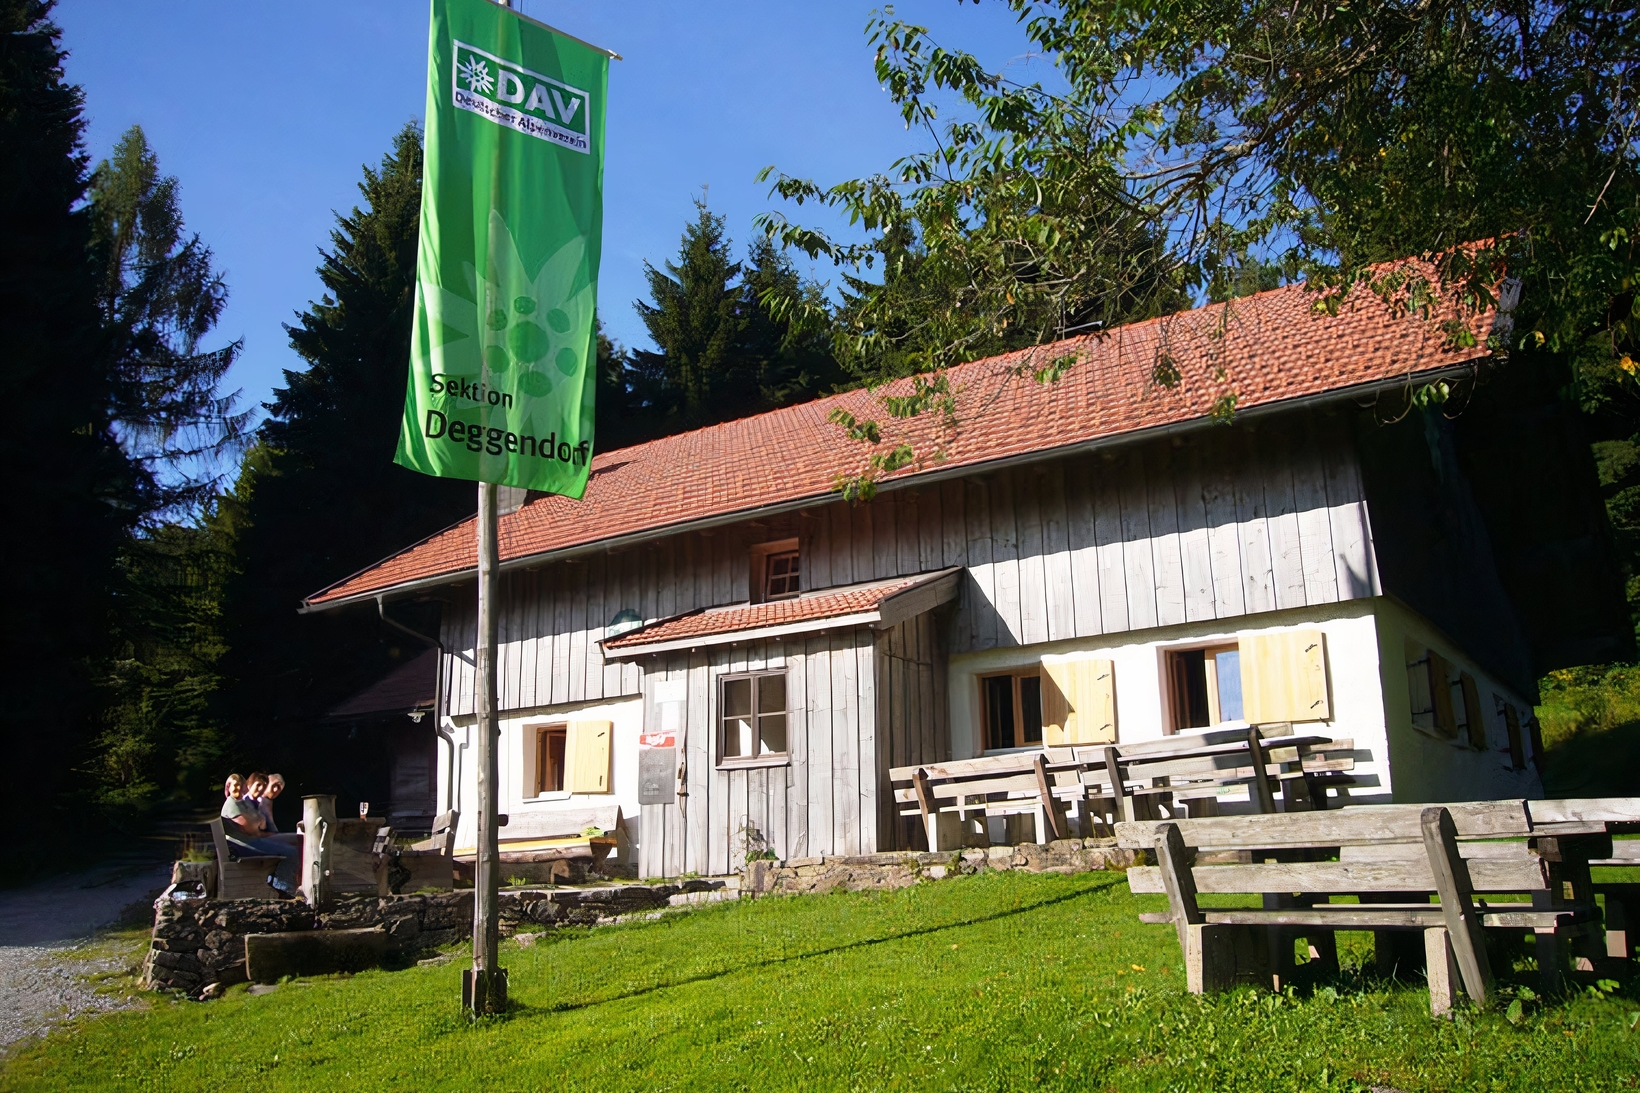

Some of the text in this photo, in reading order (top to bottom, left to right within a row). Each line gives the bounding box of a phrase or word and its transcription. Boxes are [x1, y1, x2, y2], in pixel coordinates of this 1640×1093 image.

[497, 69, 581, 125] DAV
[429, 373, 513, 409] Sektion
[425, 409, 590, 467] Deggendorf
